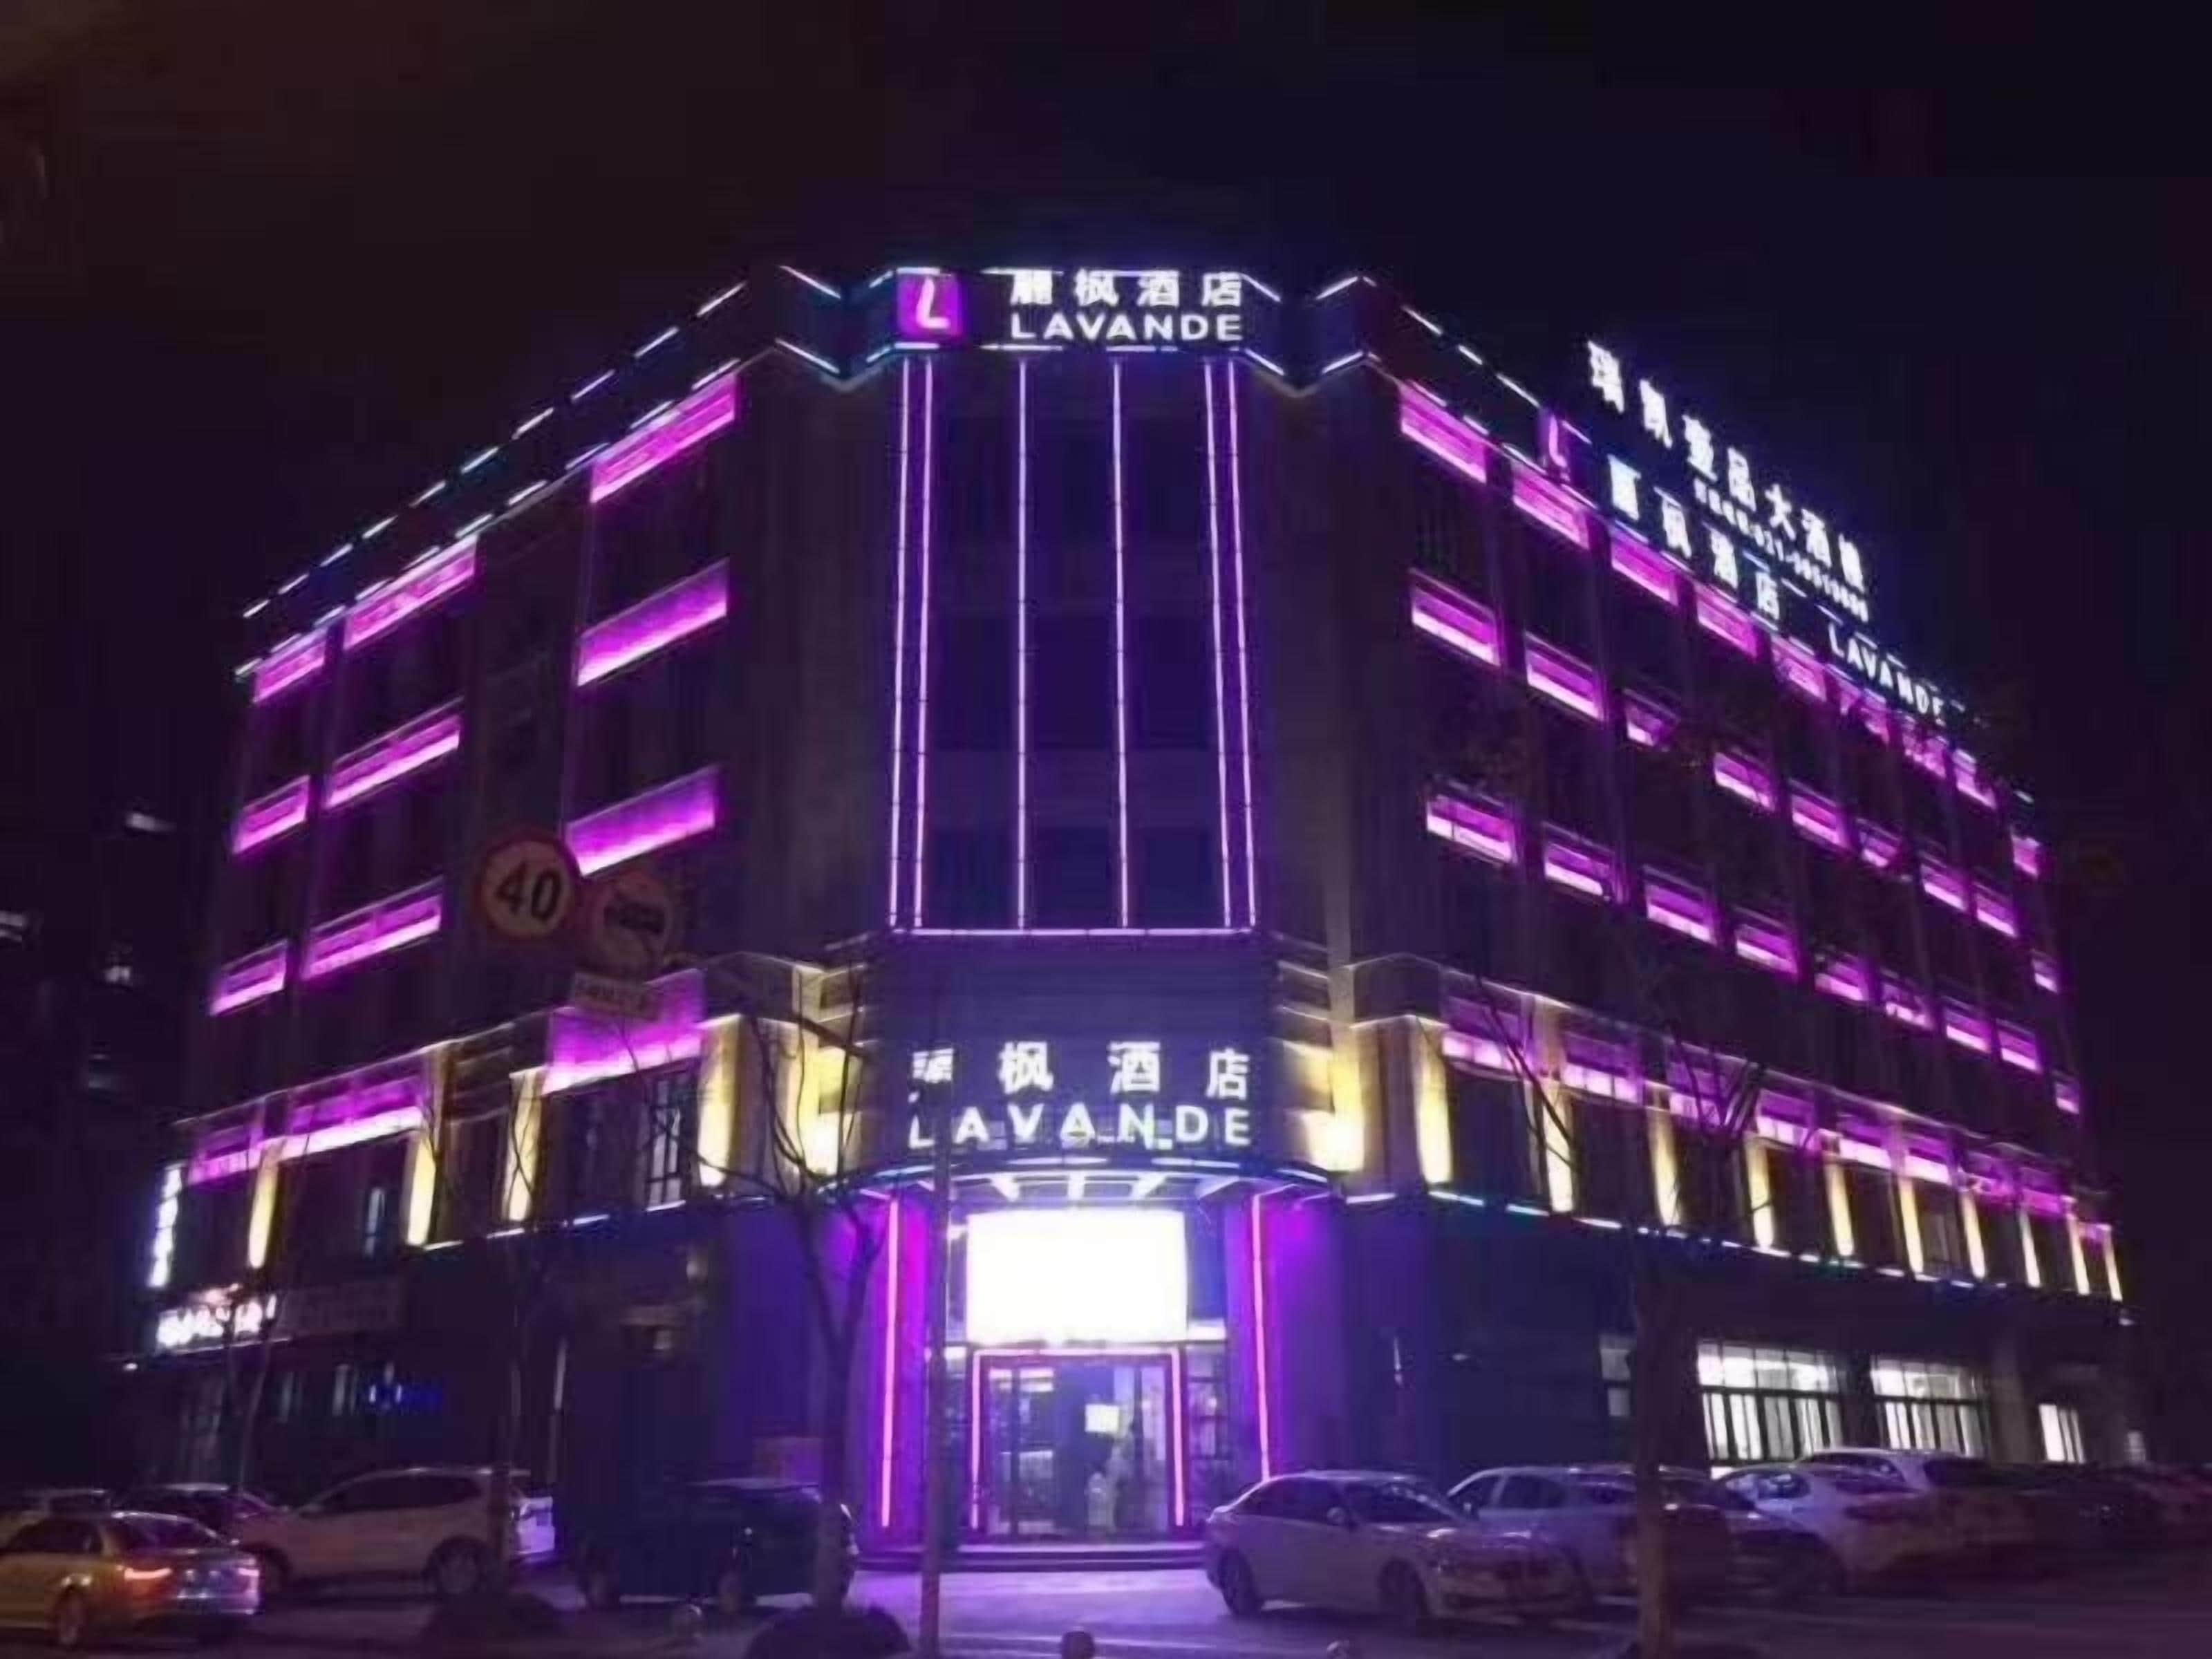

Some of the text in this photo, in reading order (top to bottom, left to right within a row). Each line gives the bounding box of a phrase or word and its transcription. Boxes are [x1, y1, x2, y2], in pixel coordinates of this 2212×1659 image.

[1011, 312, 1243, 341] LAVANDE
[1828, 623, 1947, 727] LAVANDE
[494, 863, 562, 924] 40
[908, 1103, 1252, 1150] LAVANDE
